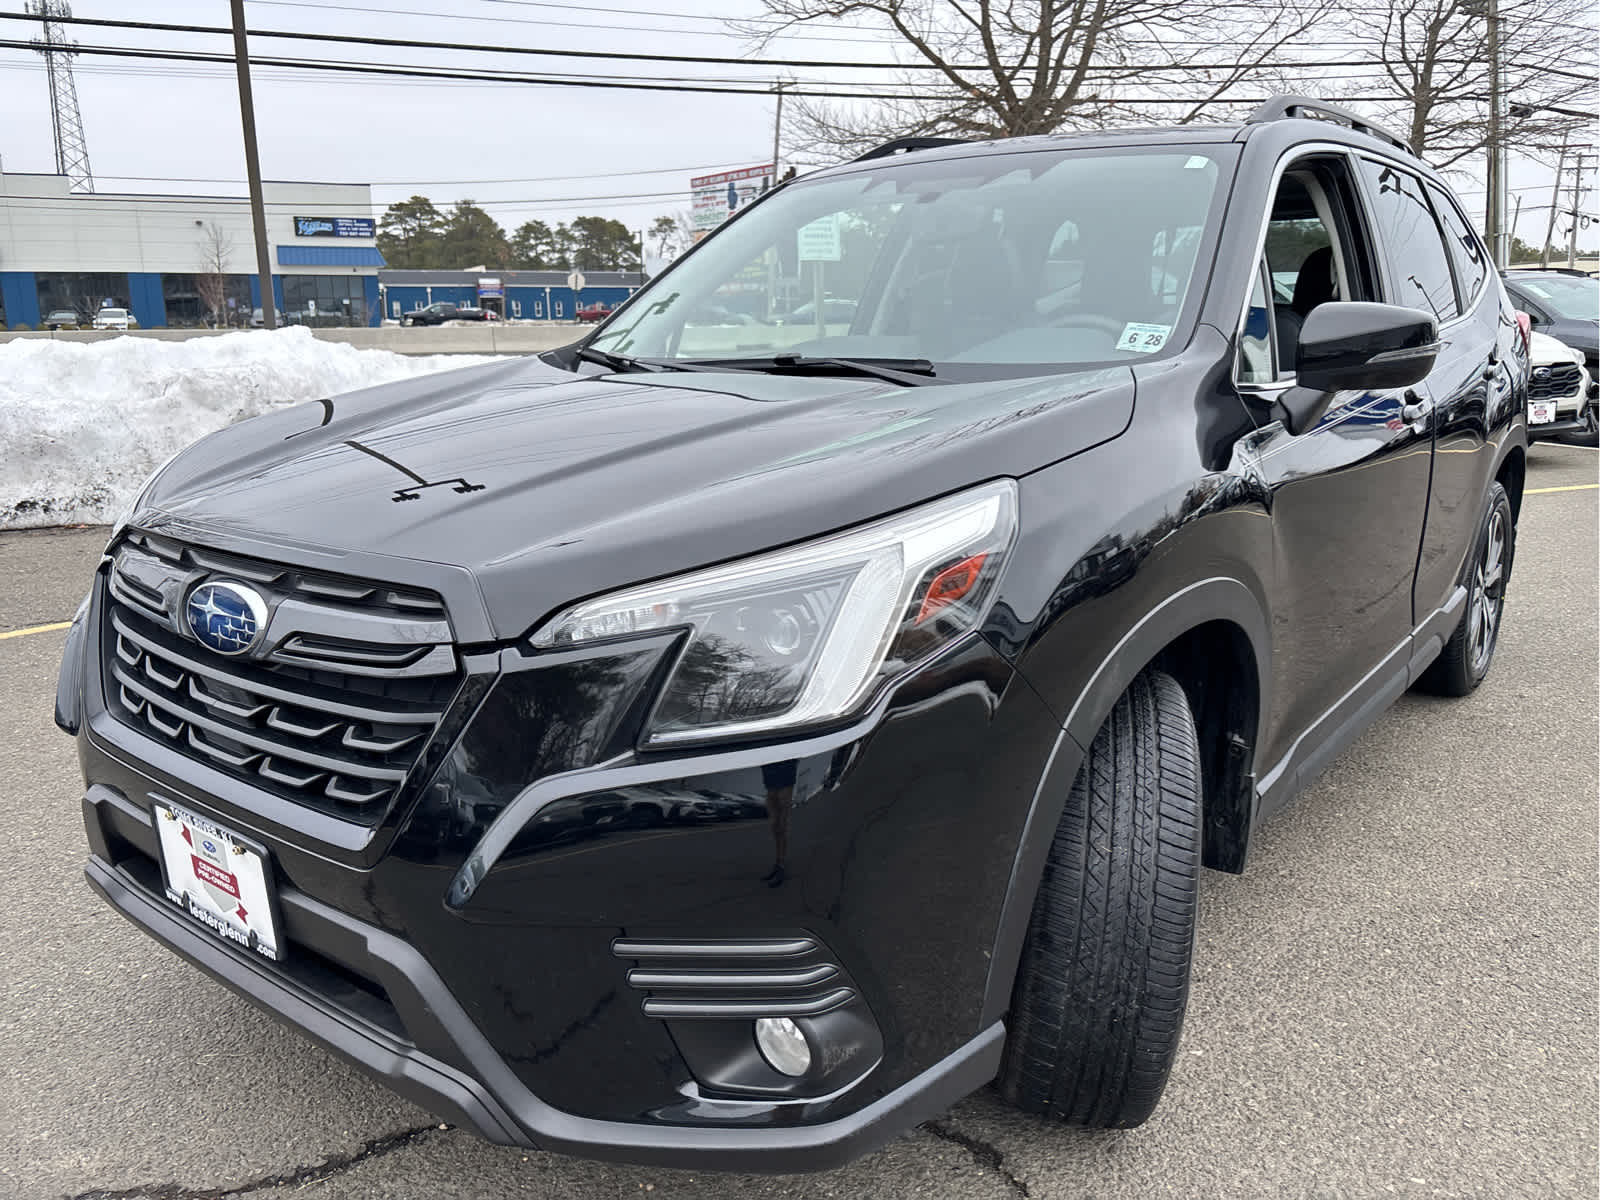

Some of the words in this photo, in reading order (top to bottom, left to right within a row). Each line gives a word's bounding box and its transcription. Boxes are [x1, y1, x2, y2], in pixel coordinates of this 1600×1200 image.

[1128, 332, 1139, 344] 6
[1144, 334, 1163, 346] 28
[197, 868, 236, 893] PRE-OWNED
[199, 860, 231, 883] CERTIFIED
